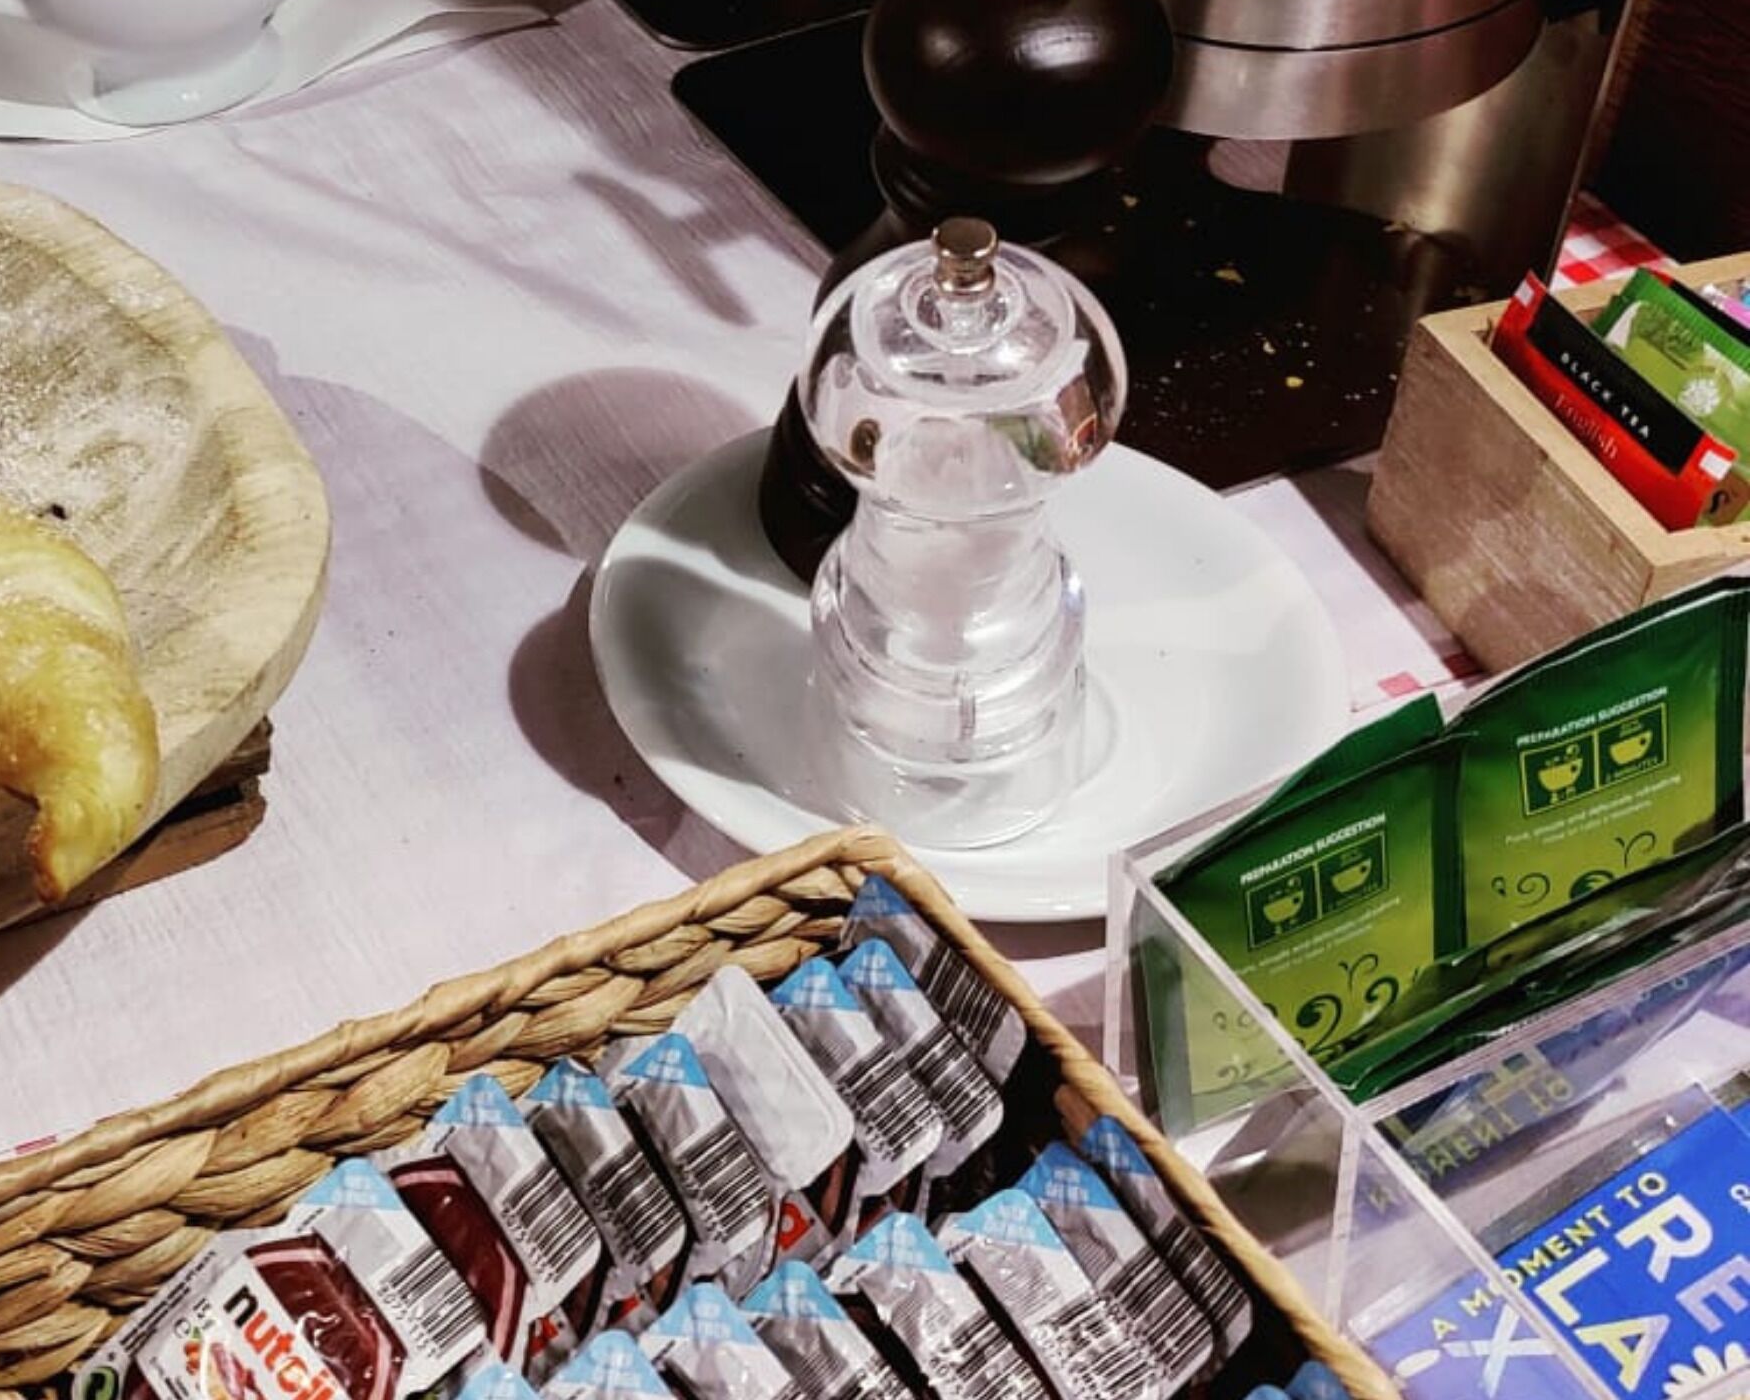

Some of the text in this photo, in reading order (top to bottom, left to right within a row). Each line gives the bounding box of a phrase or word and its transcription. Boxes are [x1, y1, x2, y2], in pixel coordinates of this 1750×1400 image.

[1560, 351, 1650, 439] BLACK TEA
[1516, 715, 1596, 748] PREPARATION
[1597, 686, 1668, 721] SUGGESTION
[1240, 813, 1386, 886] PREPARATION SUGGESTION
[1431, 1171, 1668, 1341] A MOMENT TO
